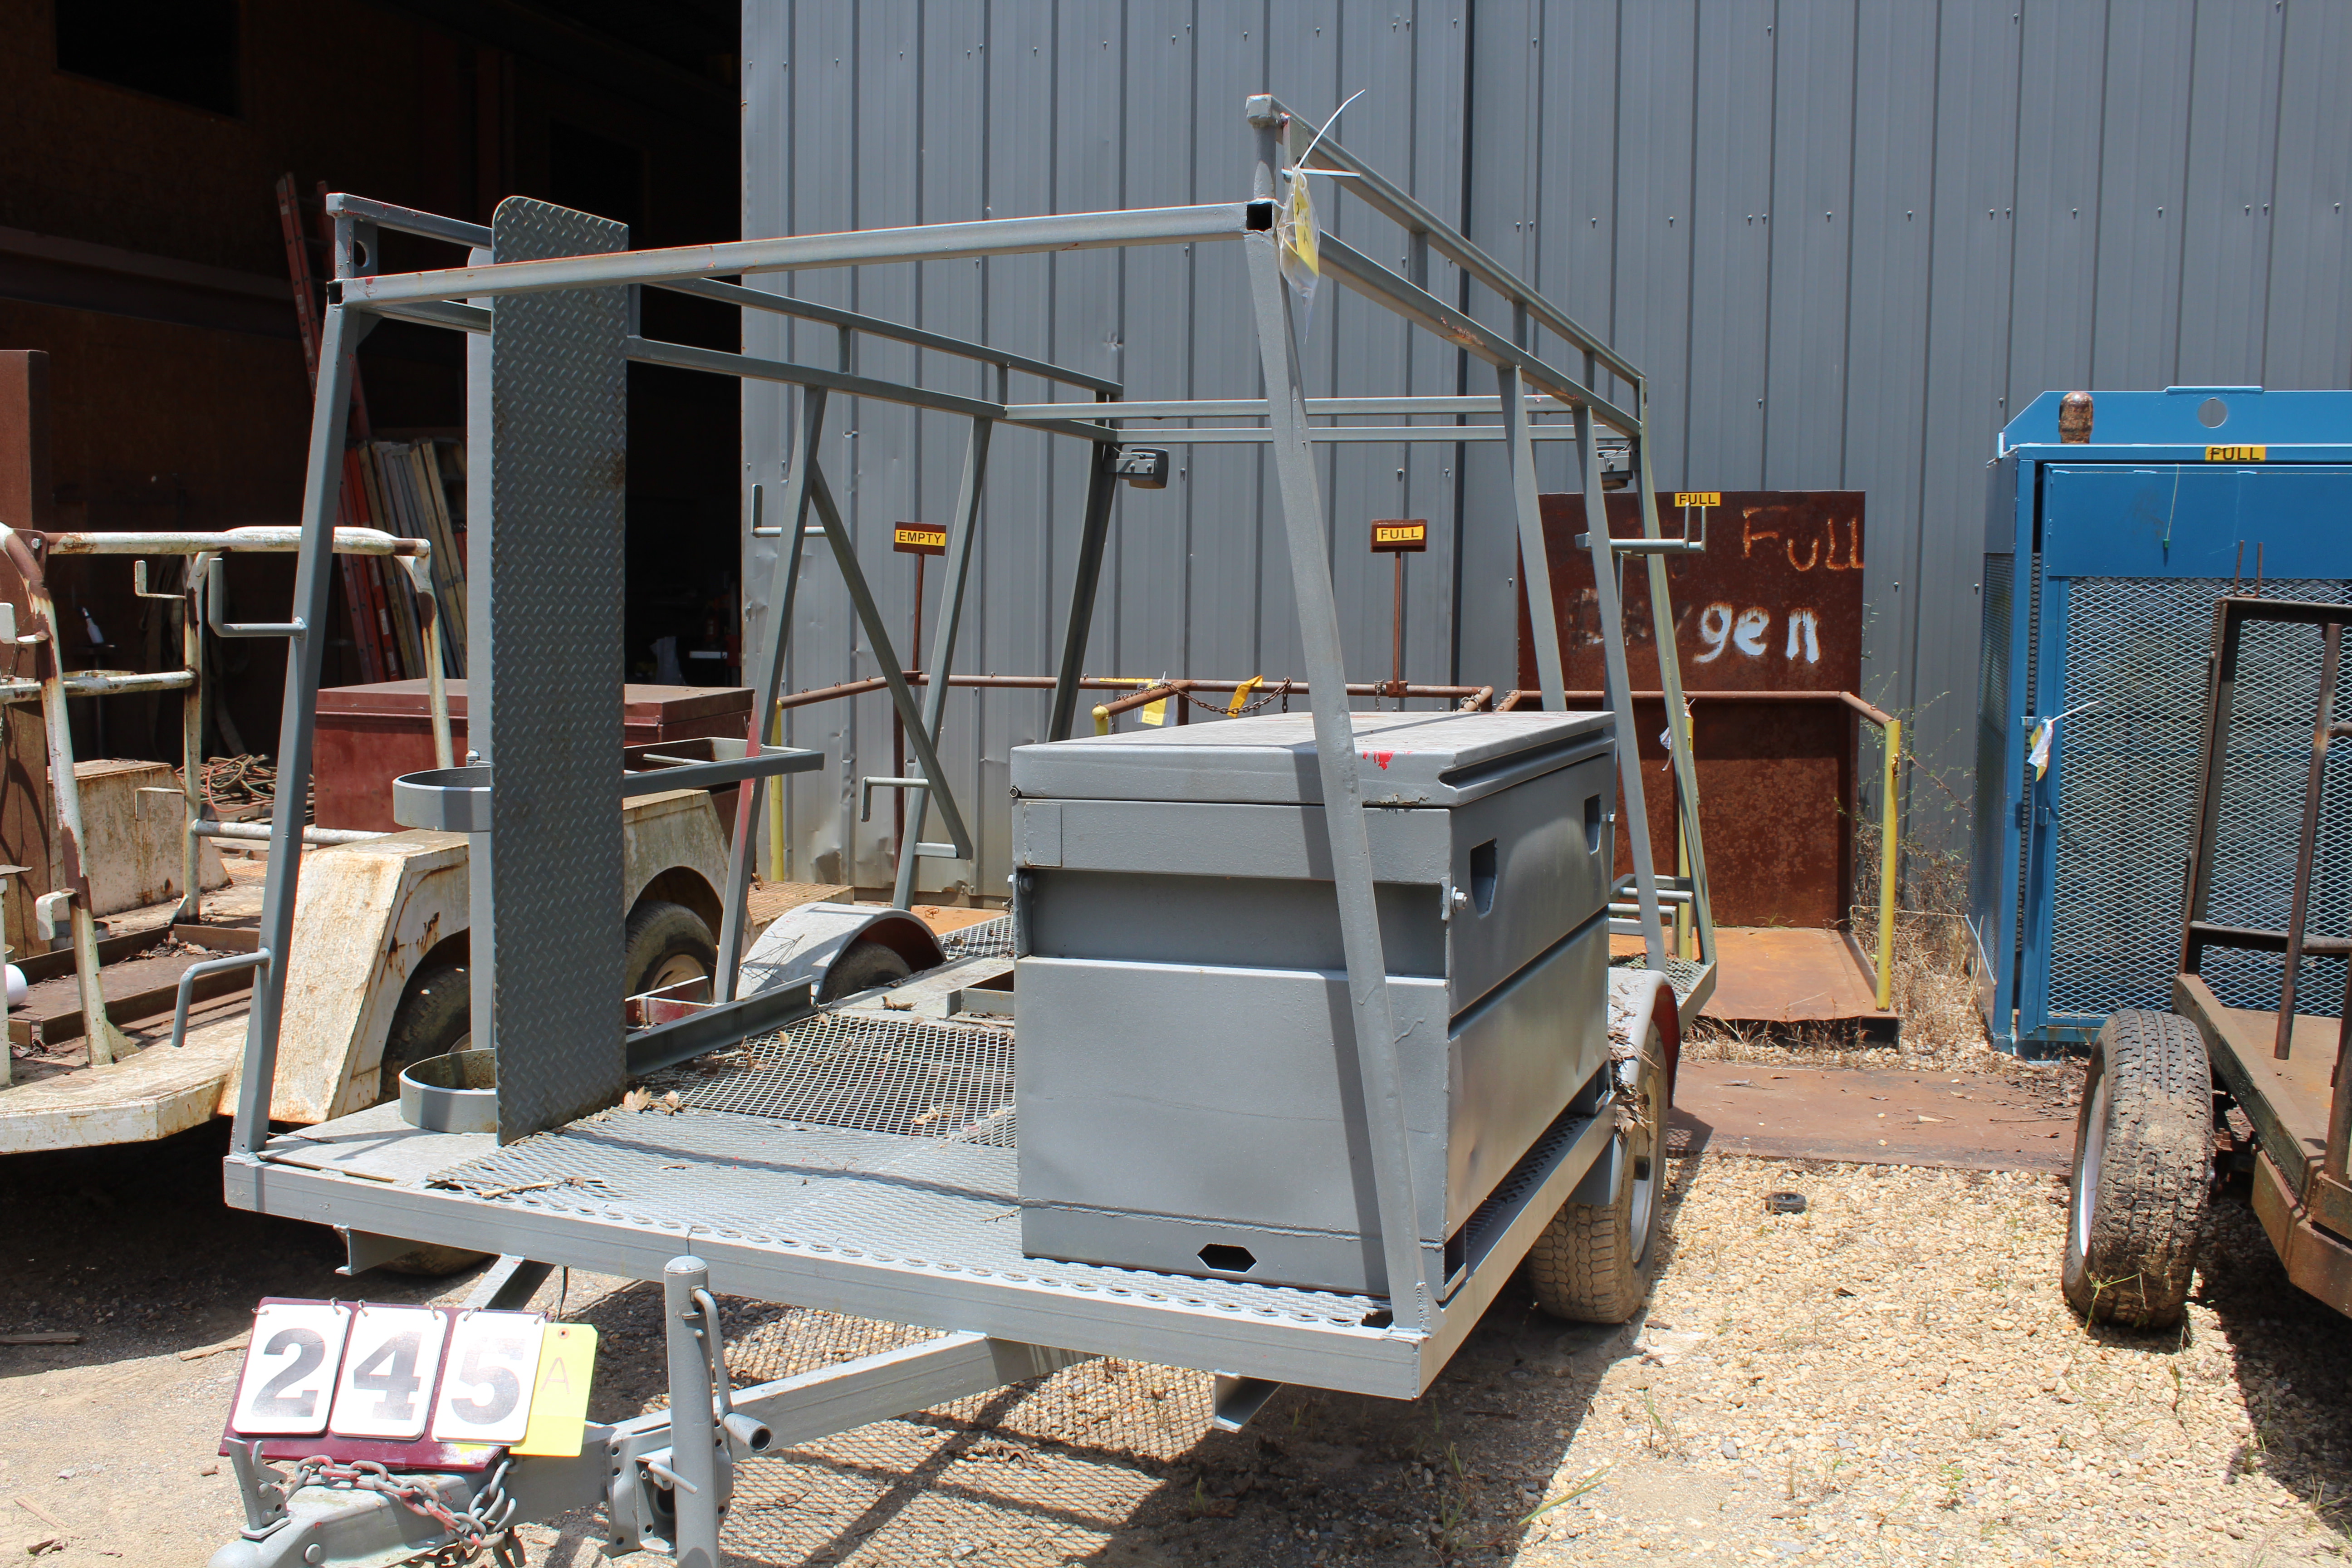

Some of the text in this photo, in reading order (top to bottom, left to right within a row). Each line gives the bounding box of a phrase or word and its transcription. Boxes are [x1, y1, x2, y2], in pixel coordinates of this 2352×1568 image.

[2210, 447, 2260, 461] FULL
[1679, 494, 1716, 505] FULL
[899, 531, 942, 544] EMPTY
[1381, 528, 1419, 539] FULL
[250, 1328, 527, 1425] 245
[540, 1357, 571, 1395] A
